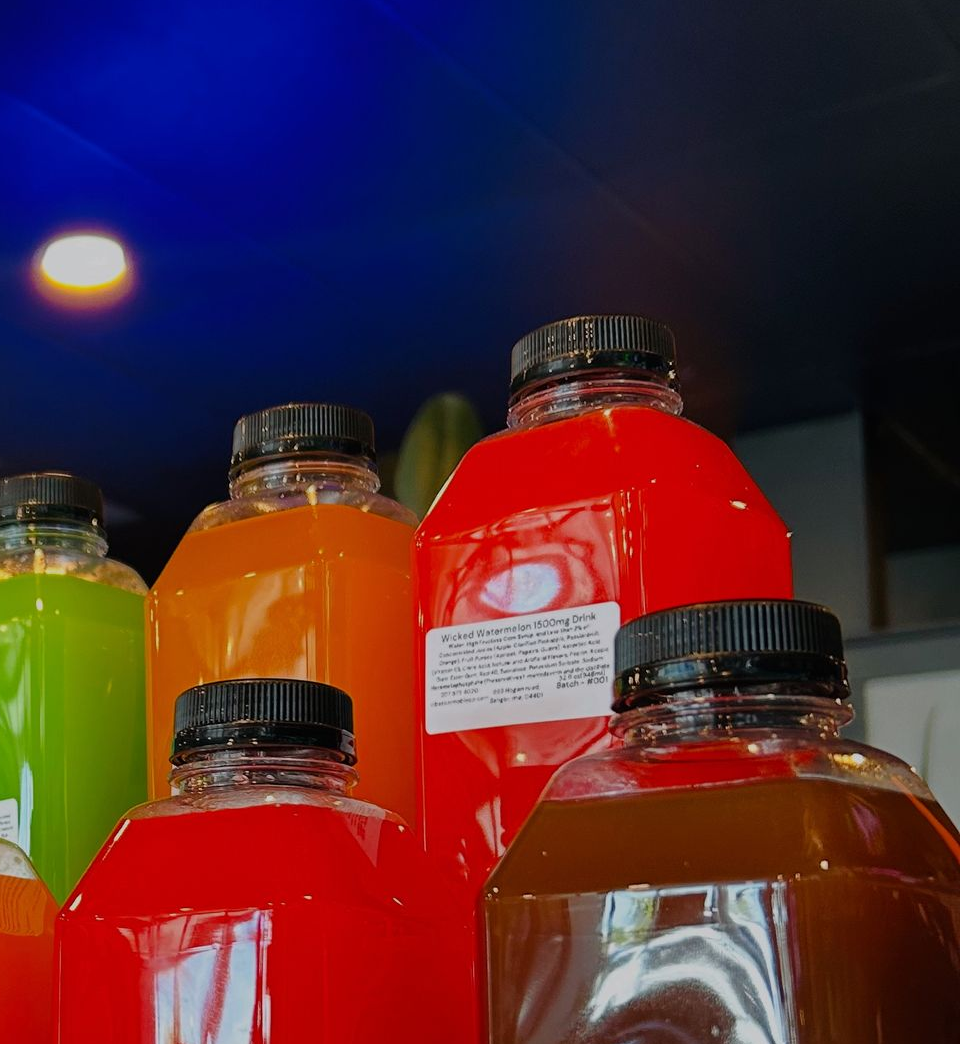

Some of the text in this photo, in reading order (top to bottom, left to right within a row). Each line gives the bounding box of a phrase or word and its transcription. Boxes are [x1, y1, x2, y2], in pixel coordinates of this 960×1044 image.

[441, 612, 596, 643] Wicked Watermelon 1500mg Drink
[556, 680, 579, 689] Batch
[587, 676, 608, 685] #001
